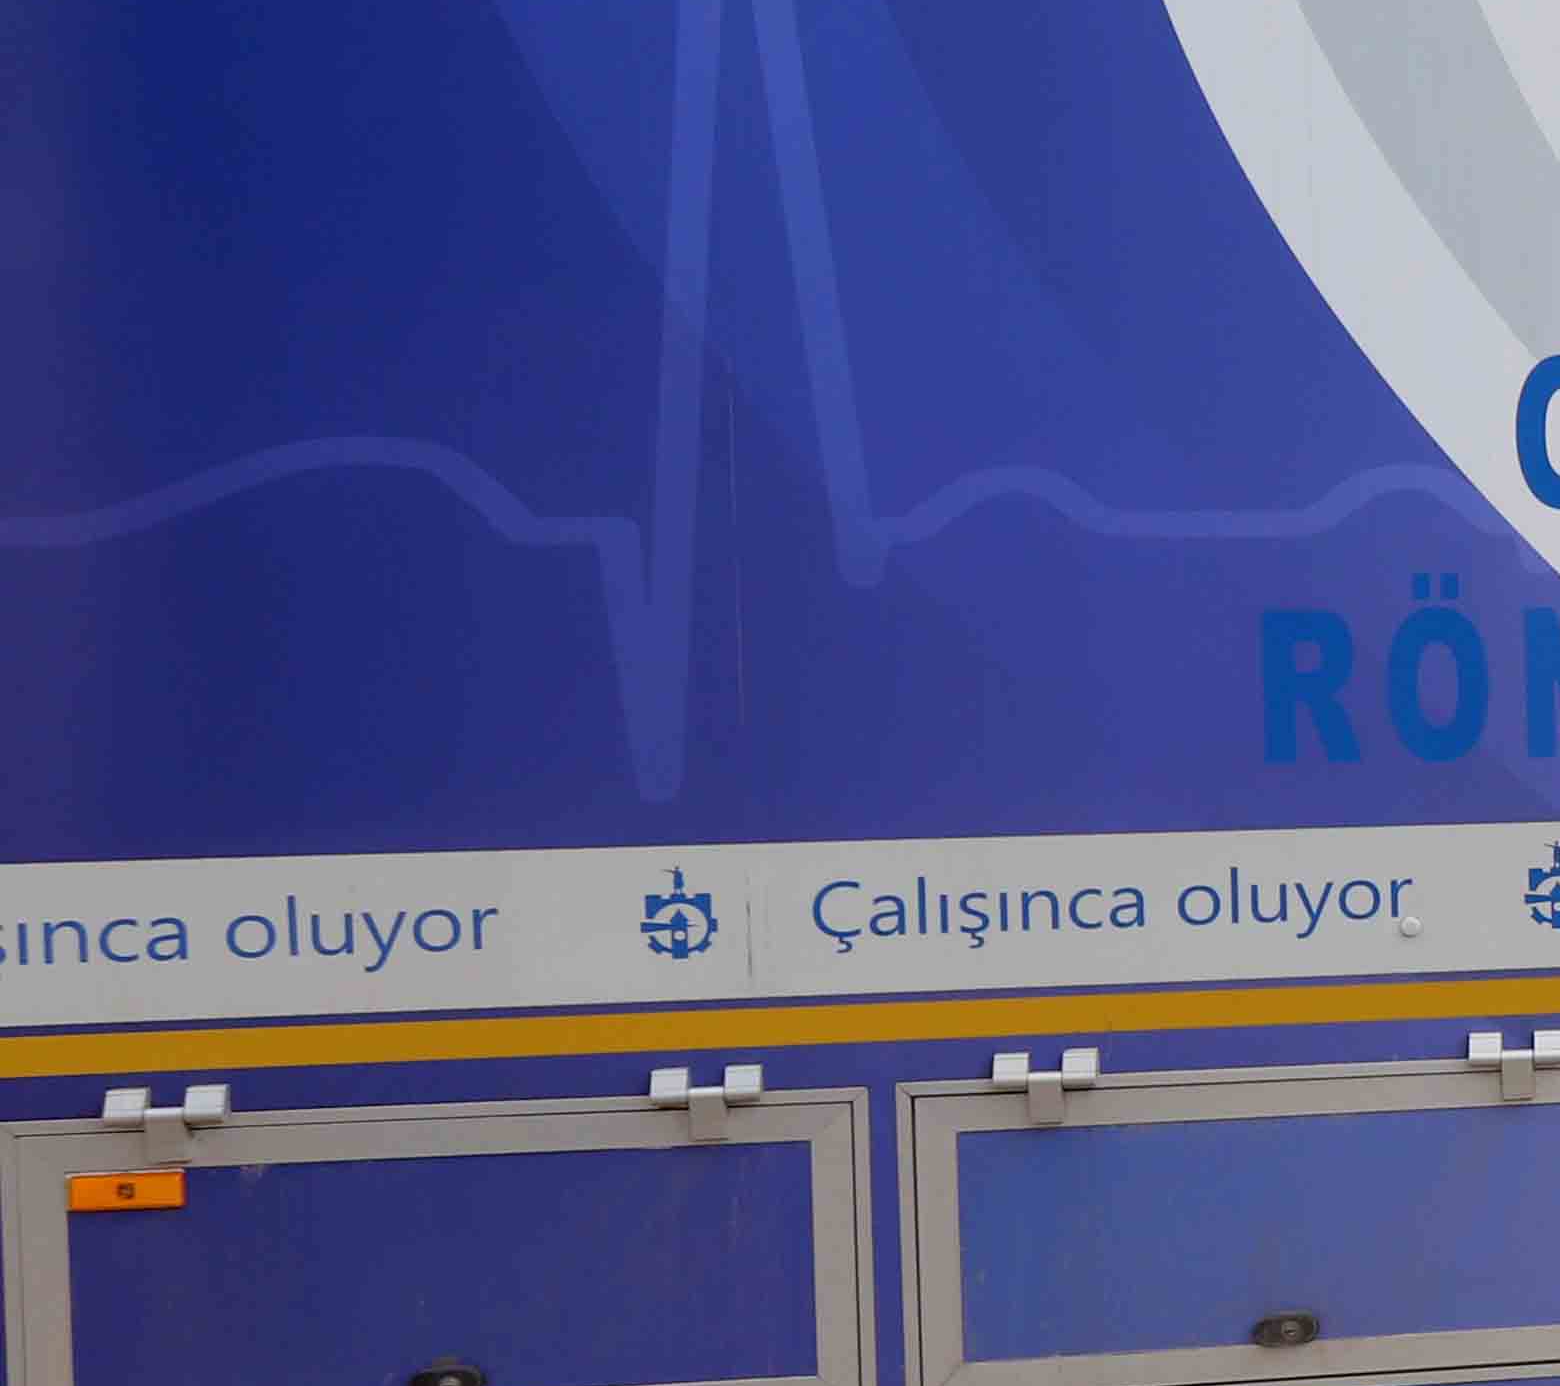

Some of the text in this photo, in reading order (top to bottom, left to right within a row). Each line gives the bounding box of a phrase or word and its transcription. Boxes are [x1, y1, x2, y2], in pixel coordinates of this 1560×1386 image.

[225, 893, 500, 972] oluyor
[811, 865, 1416, 953] Çalışınca oluyor
